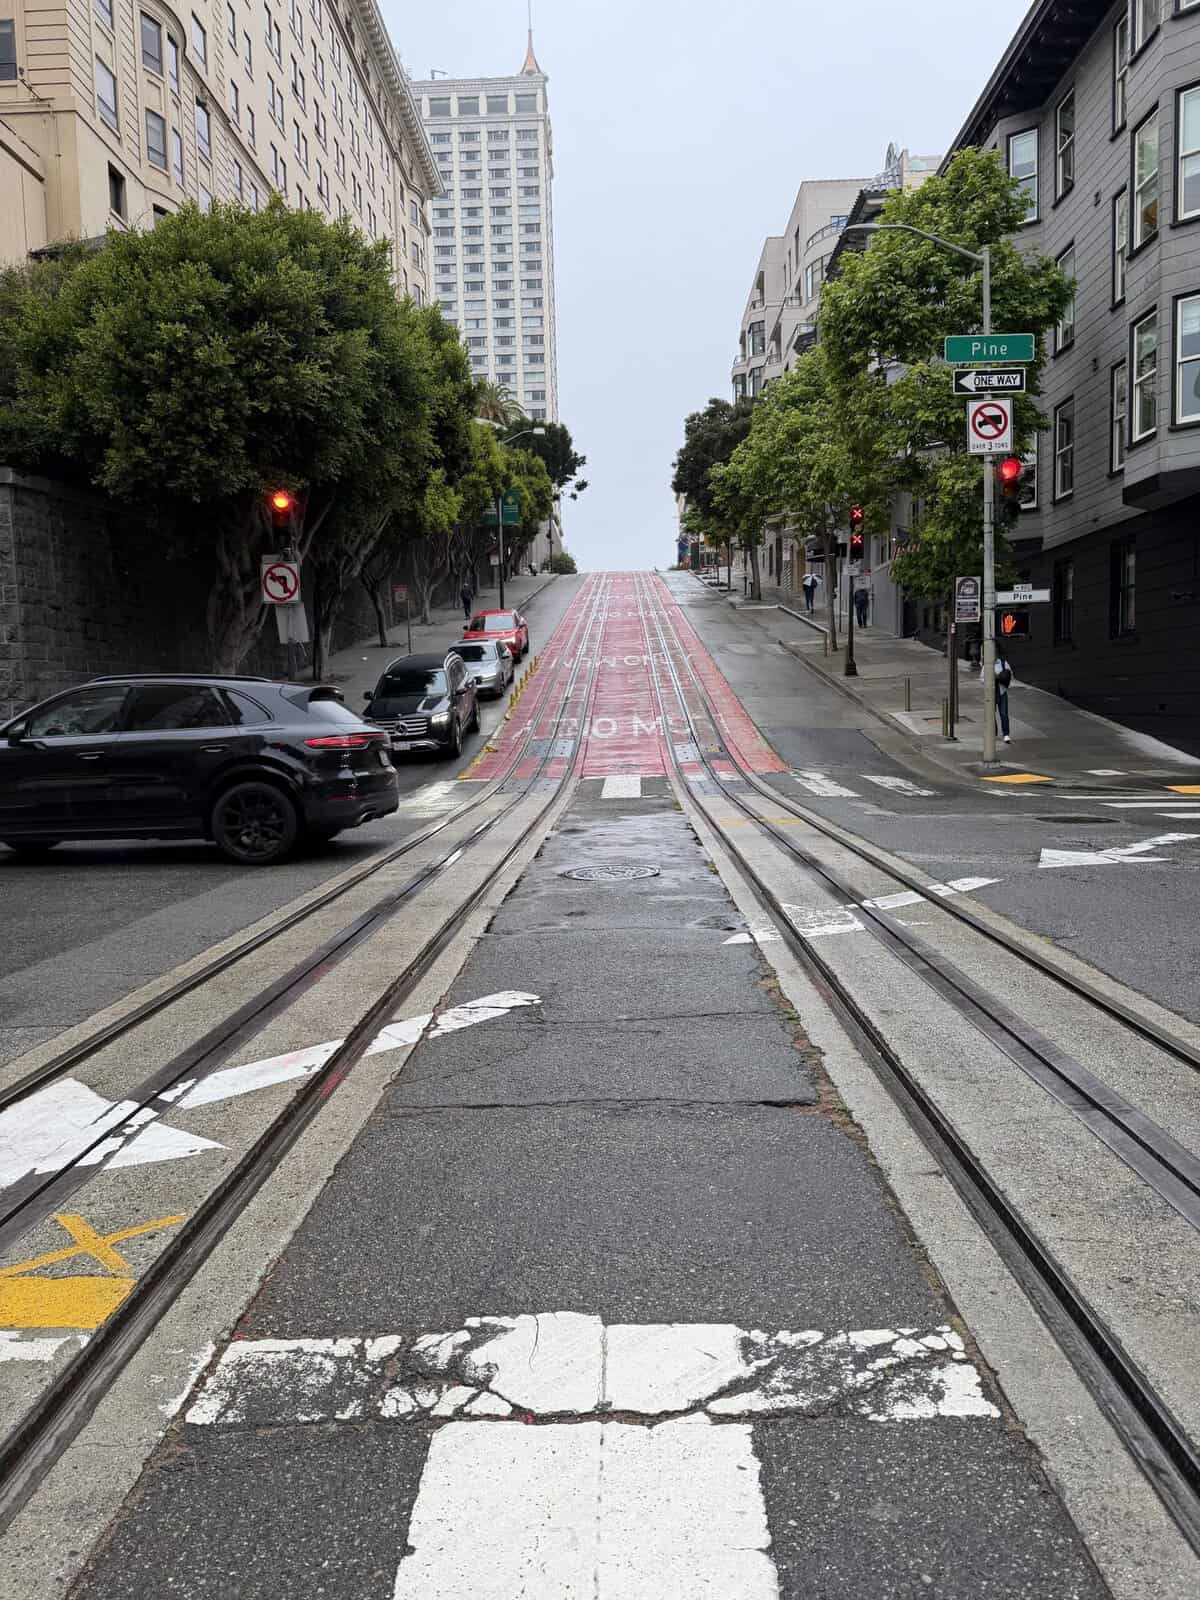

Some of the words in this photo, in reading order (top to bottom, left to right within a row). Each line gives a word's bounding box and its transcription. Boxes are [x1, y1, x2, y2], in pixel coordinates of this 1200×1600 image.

[971, 342, 1008, 356] Pine
[973, 376, 994, 386] ONE
[997, 375, 1018, 385] WAY
[1014, 592, 1033, 601] Pine
